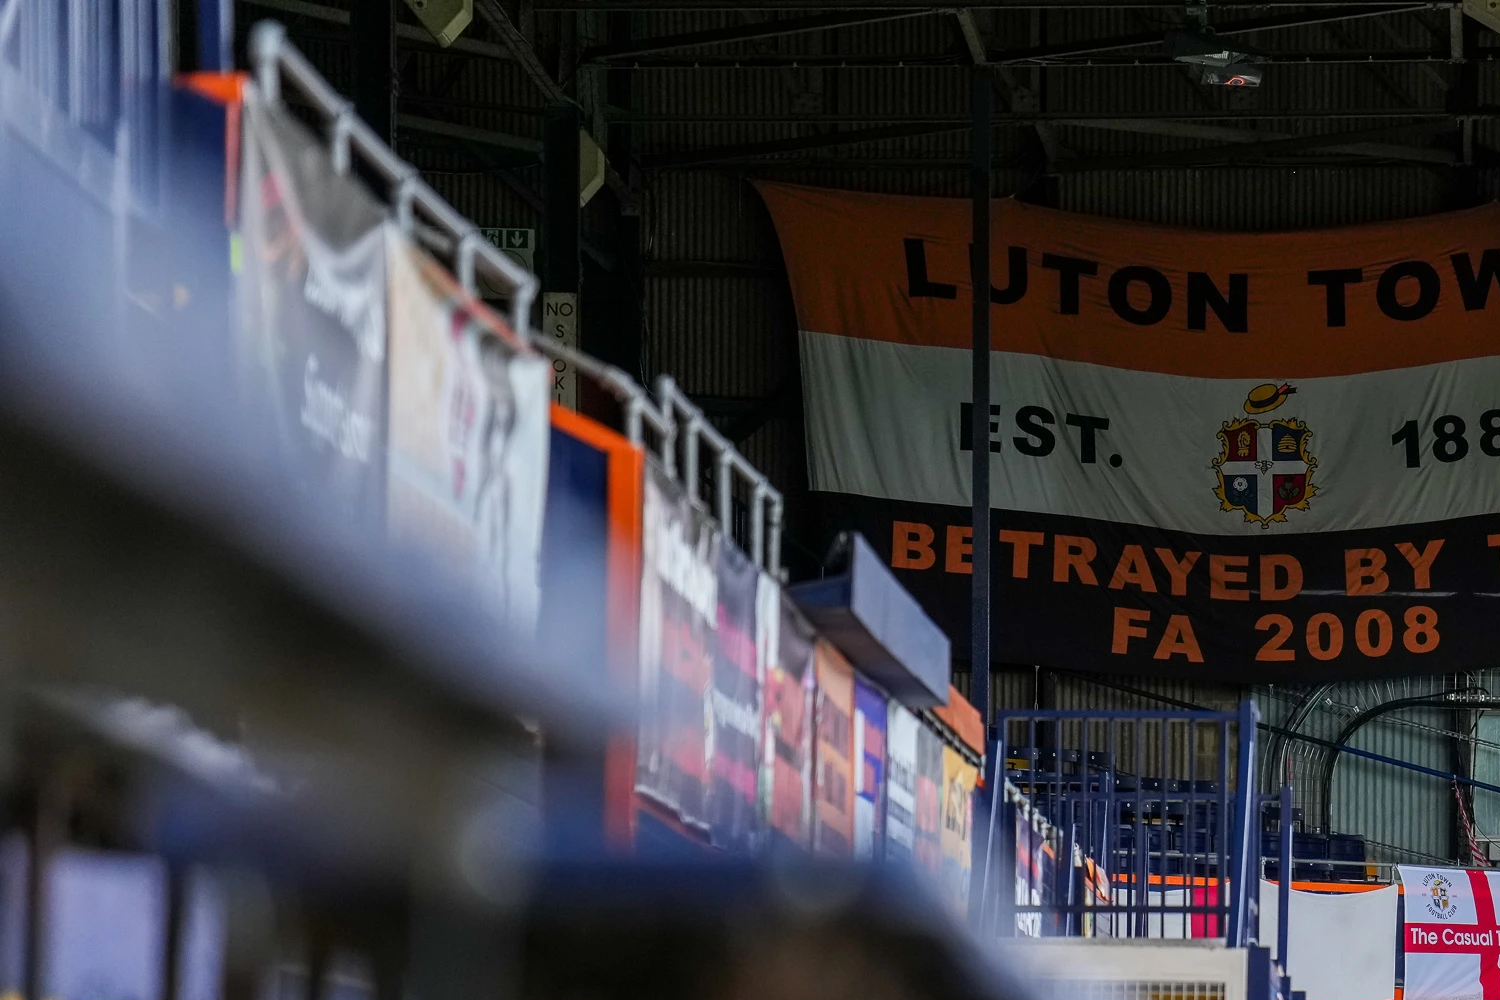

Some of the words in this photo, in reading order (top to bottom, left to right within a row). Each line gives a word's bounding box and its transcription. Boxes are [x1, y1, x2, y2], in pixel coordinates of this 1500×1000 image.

[546, 302, 574, 316] NO
[903, 238, 1248, 333] LUTON
[960, 402, 1123, 468] EST.
[891, 520, 1304, 601] BETRAYED
[1345, 538, 1446, 597] BY
[1111, 606, 1205, 664] FA
[1254, 605, 1441, 662] 2008
[1422, 873, 1436, 887] LUTON
[1436, 873, 1453, 888] TOWN
[1411, 928, 1438, 945] The
[1442, 928, 1493, 947] Casual
